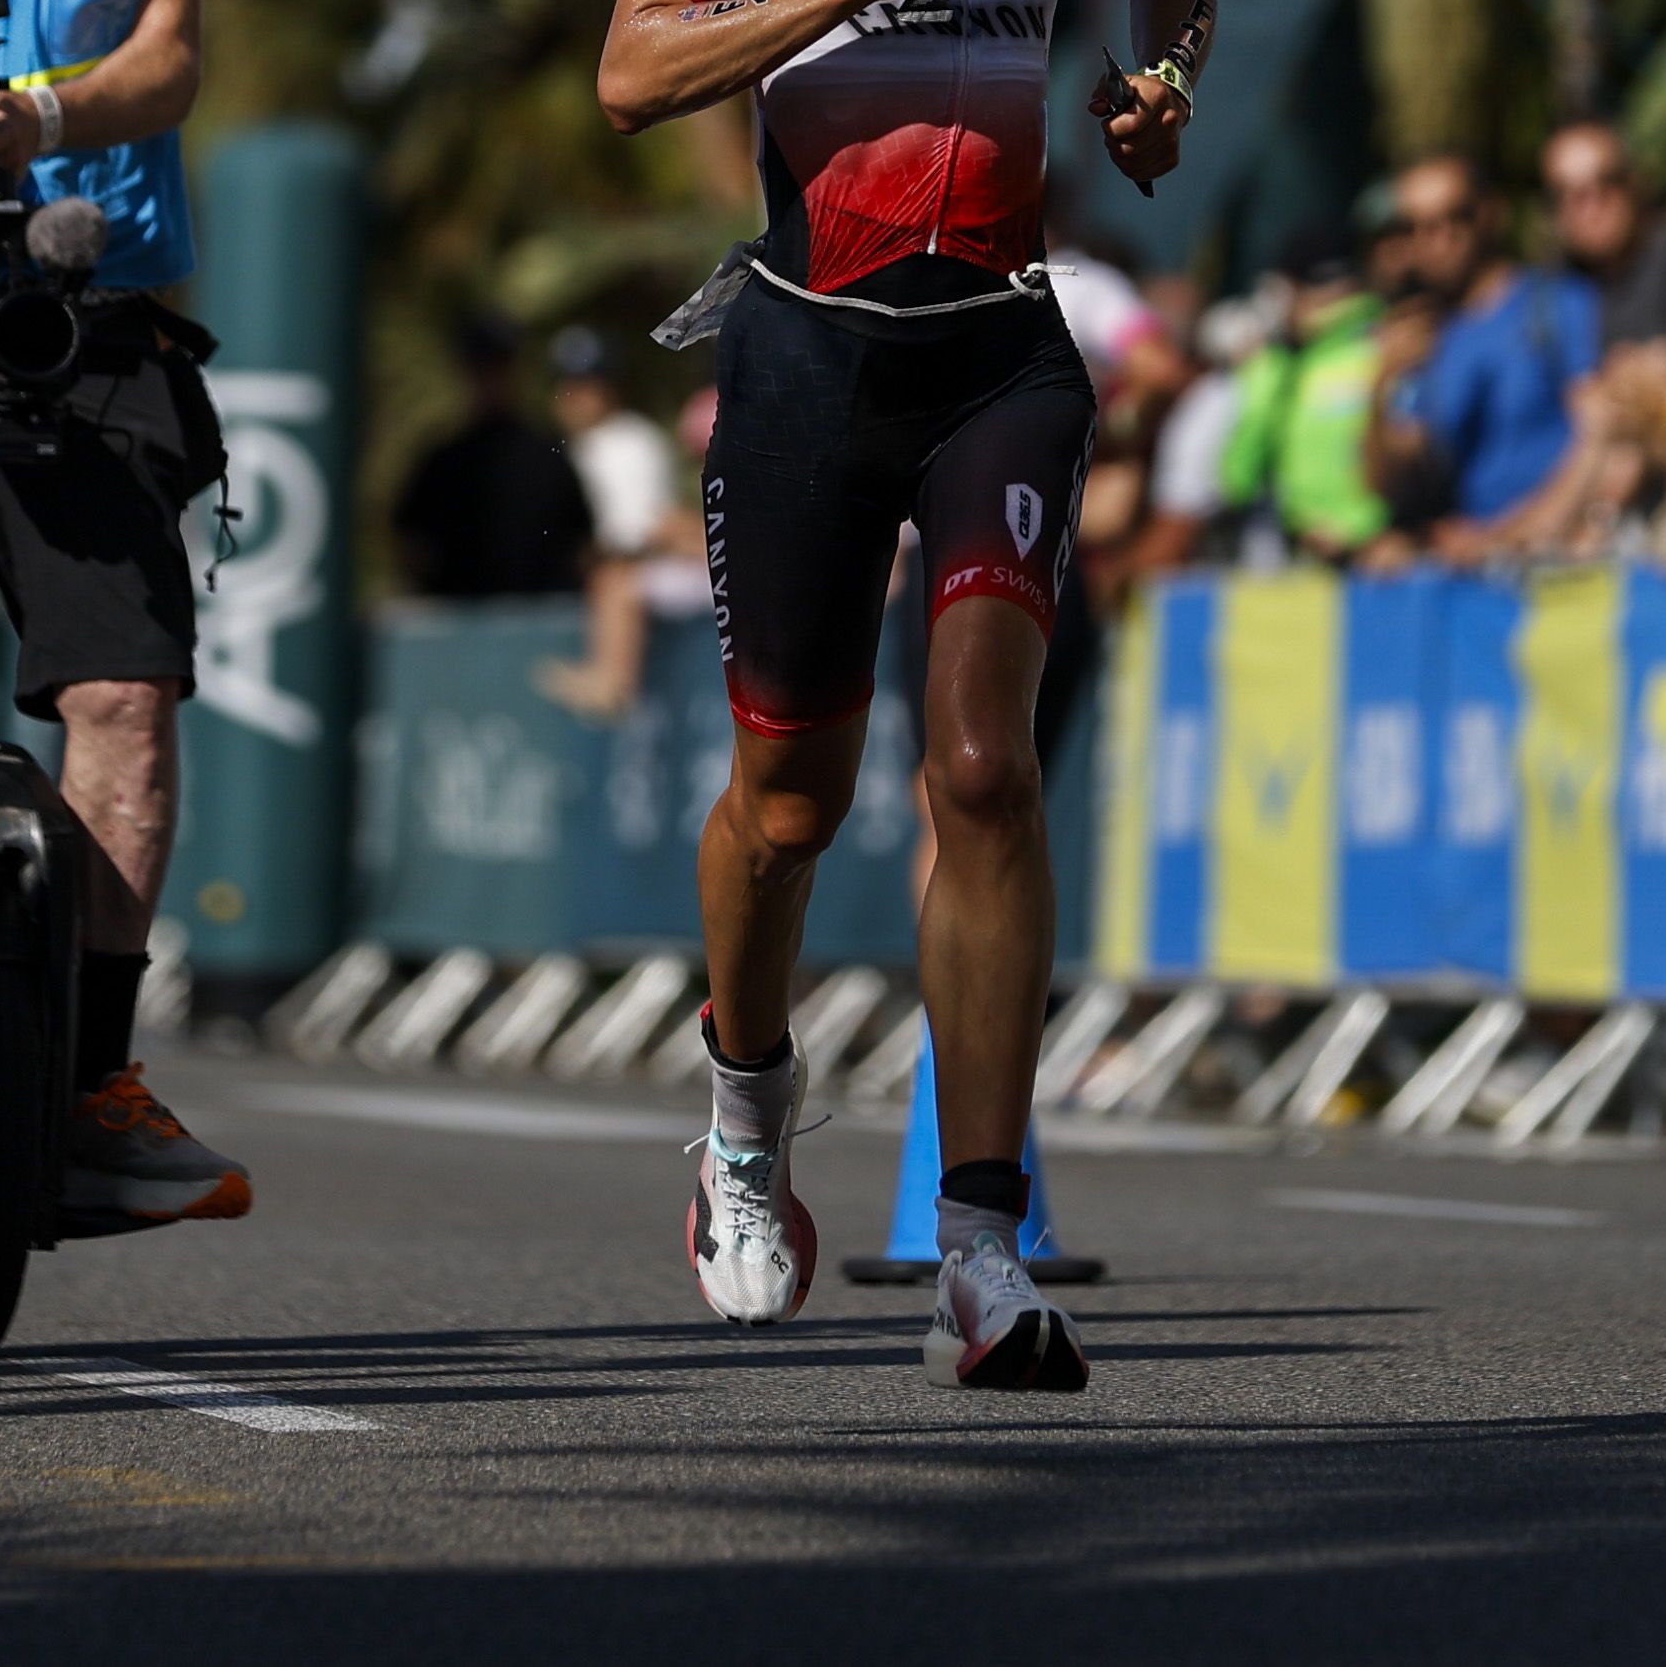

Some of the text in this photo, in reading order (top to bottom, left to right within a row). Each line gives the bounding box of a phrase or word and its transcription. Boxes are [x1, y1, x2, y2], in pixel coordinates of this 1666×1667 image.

[706, 476, 735, 663] CANYON
[944, 566, 1048, 615] DT SWISS
